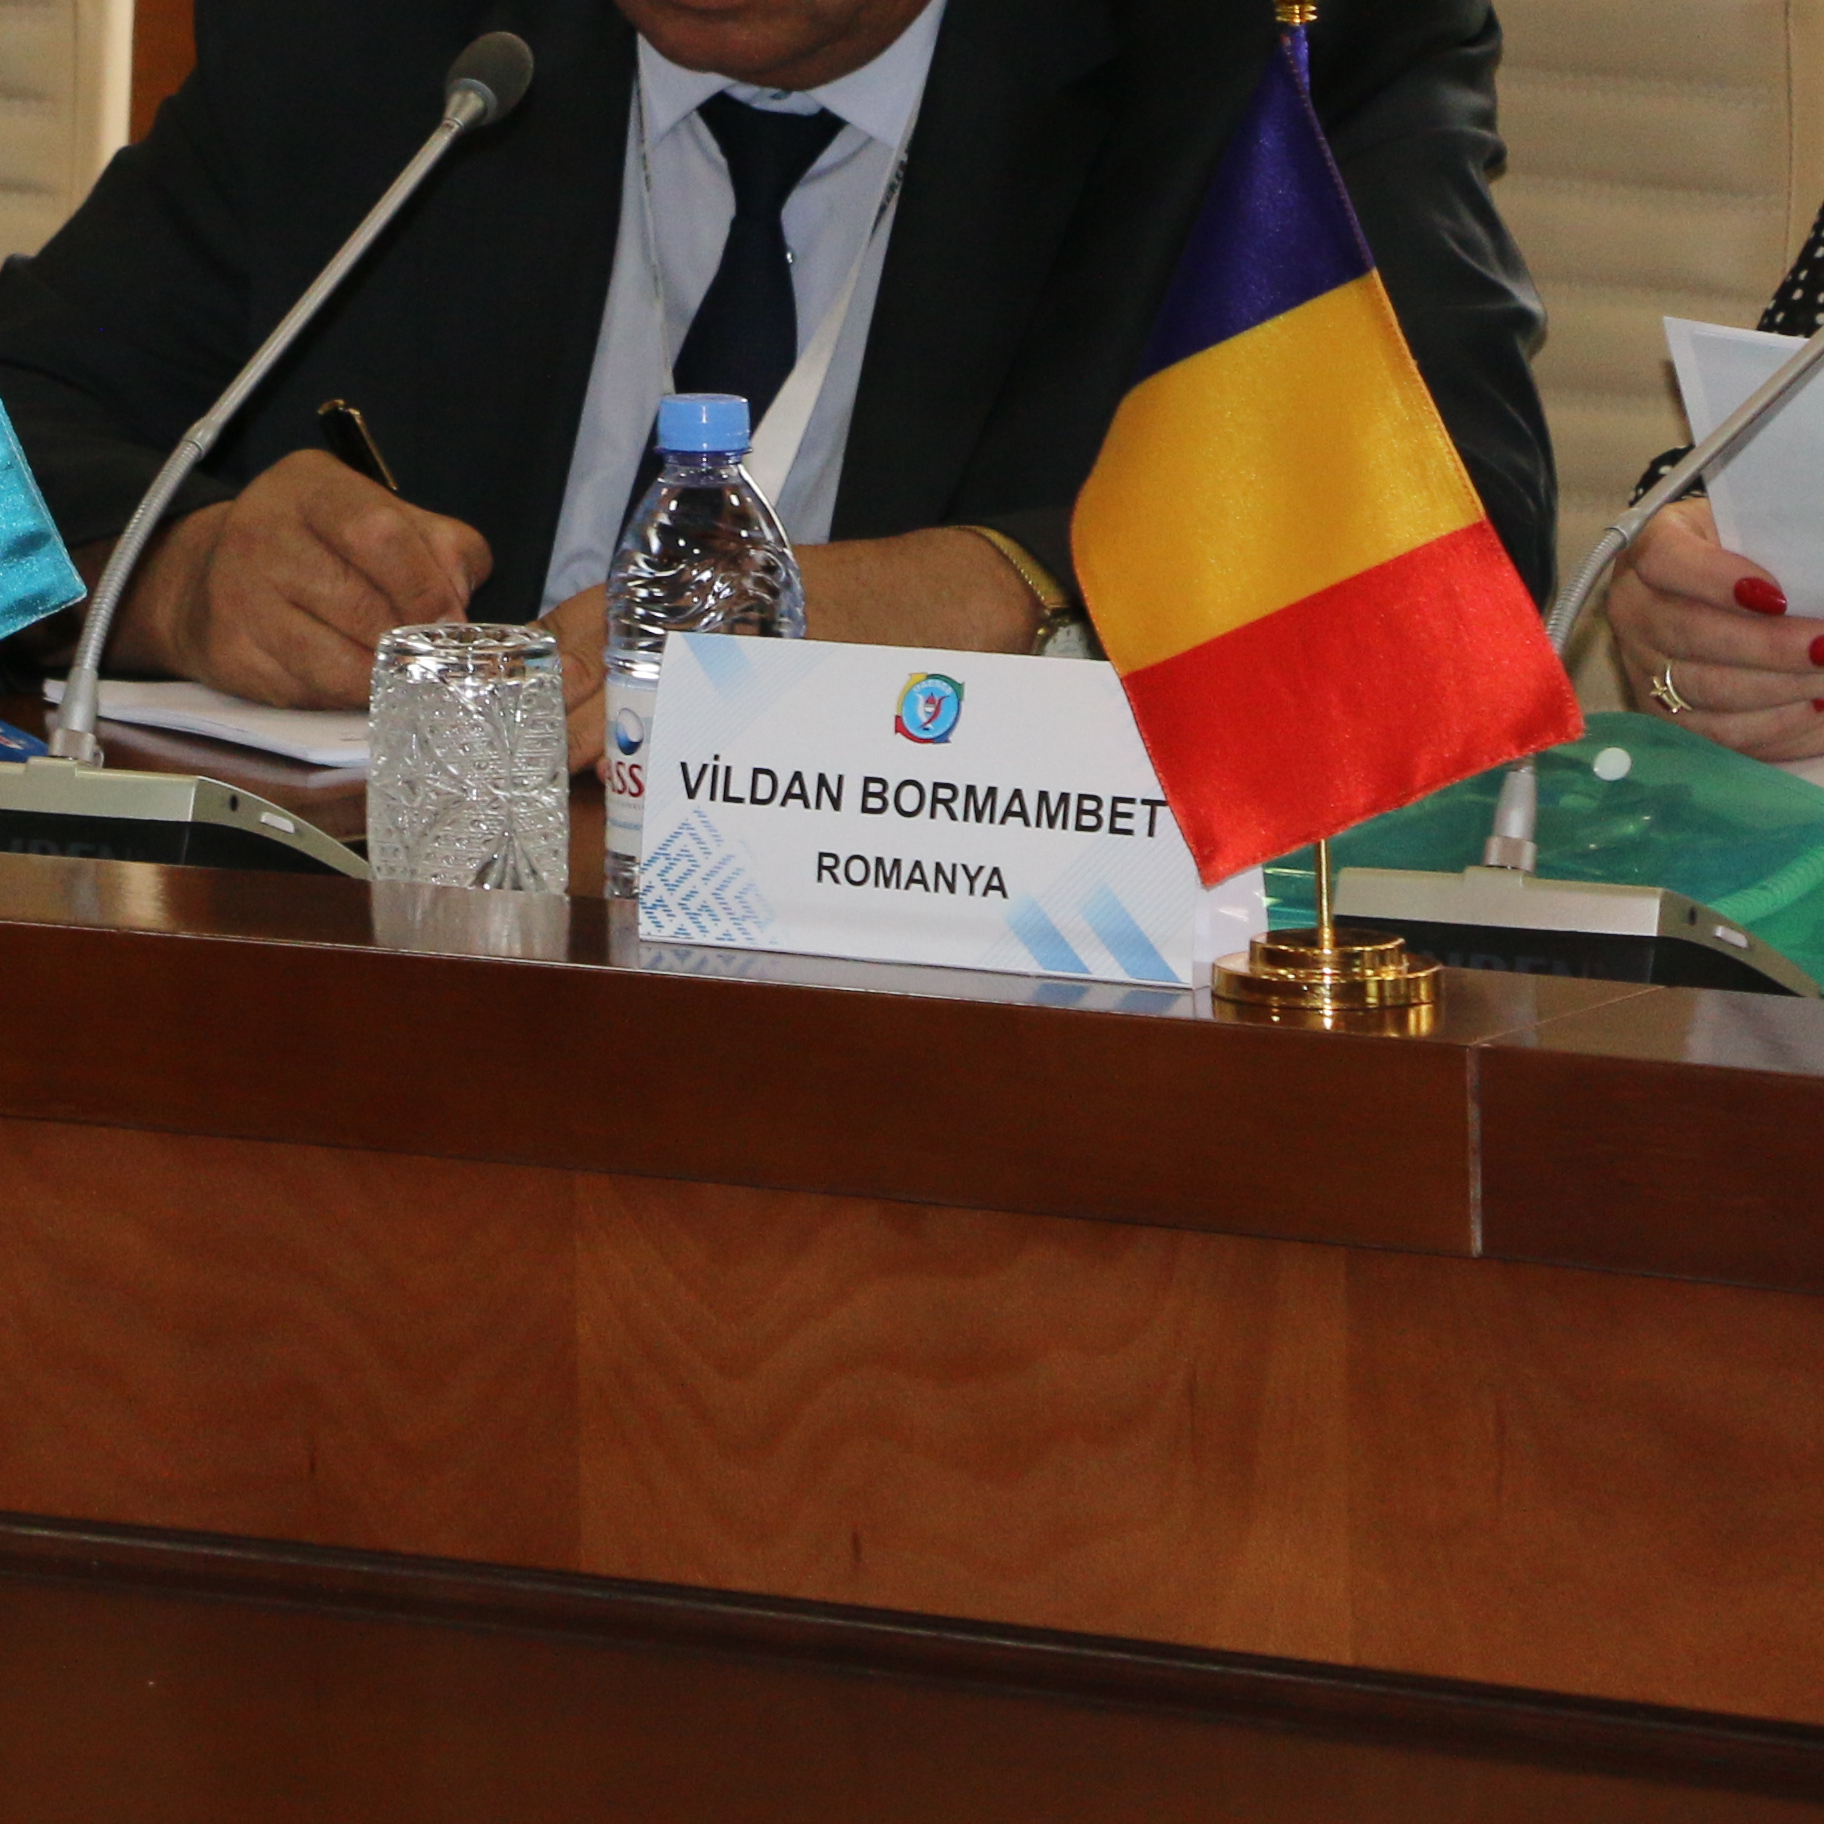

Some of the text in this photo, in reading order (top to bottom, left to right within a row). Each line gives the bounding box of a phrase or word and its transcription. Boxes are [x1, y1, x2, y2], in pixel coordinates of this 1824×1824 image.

[679, 753, 845, 812] VİLDAN
[860, 776, 1169, 838] BORMAMBET
[817, 851, 1009, 899] ROMANYA
